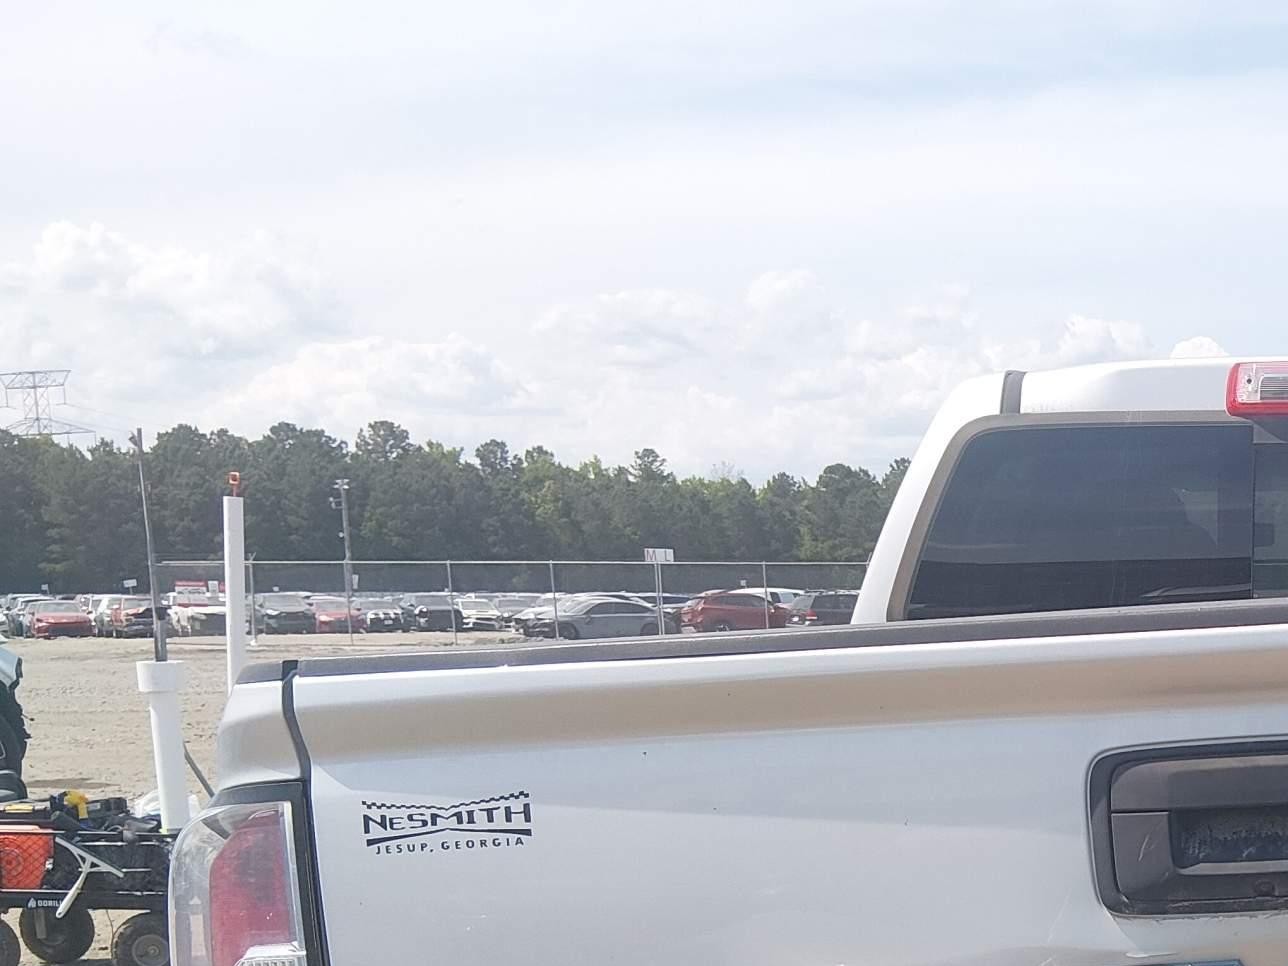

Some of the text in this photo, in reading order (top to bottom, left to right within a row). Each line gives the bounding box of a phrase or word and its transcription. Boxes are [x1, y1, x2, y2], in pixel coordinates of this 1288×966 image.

[363, 803, 532, 834] NESMITH
[376, 837, 525, 855] JESUP, GEORGIA
